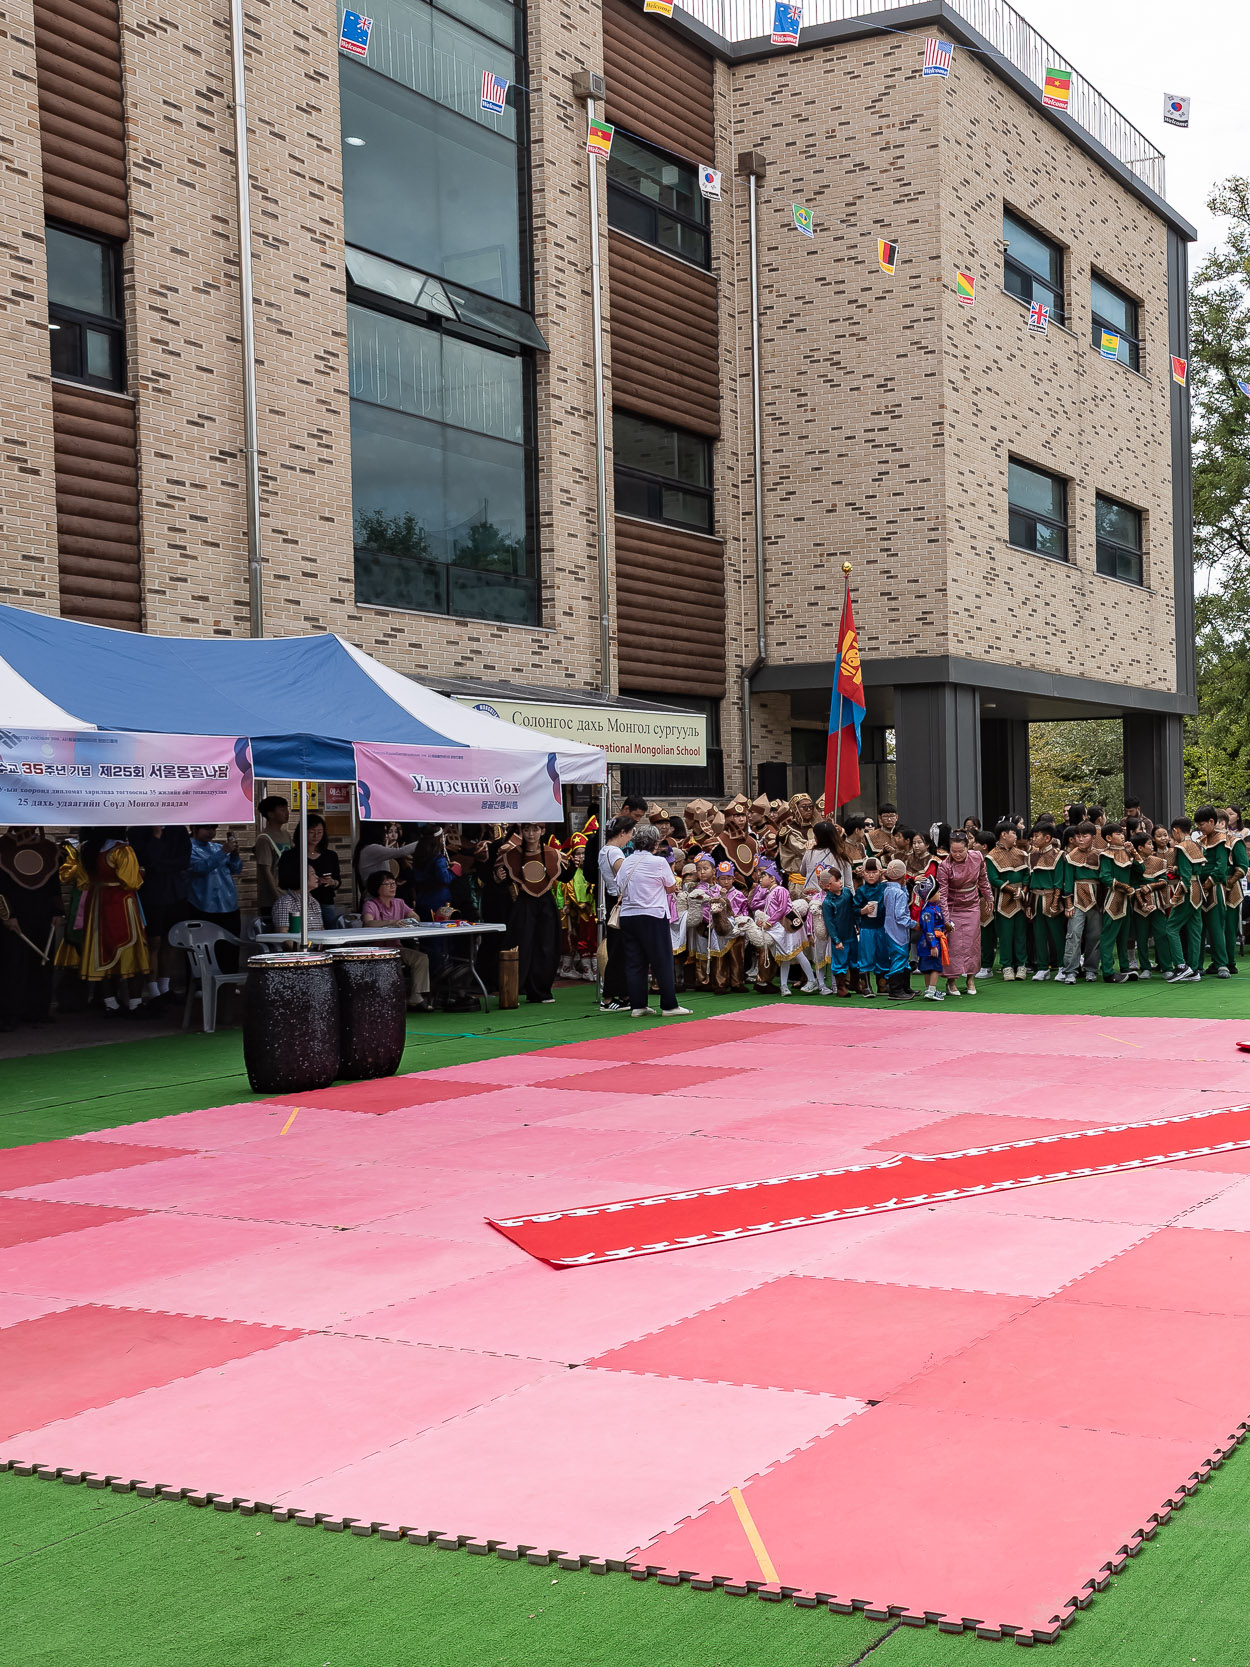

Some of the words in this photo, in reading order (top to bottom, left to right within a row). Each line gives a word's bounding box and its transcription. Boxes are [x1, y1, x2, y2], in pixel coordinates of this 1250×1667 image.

[646, 2, 671, 13] Welcome
[341, 40, 366, 55] Welcome
[482, 100, 503, 112] Welcome
[1043, 97, 1068, 108] Welcome
[1164, 117, 1188, 127] Welcome
[588, 146, 608, 158] Welcome
[512, 711, 573, 730] Солонгос
[577, 719, 604, 732] дахь
[607, 718, 650, 734] Монгол
[653, 724, 699, 739] сургууль
[634, 743, 674, 757] Mongolian
[676, 745, 700, 756] School
[22, 763, 66, 776] 35주년
[70, 765, 91, 776] 기념
[100, 765, 145, 778] 제25회
[149, 765, 228, 779] 서울몽골나담
[412, 776, 490, 793] Үндэсний
[495, 778, 520, 794] бөх
[18, 798, 29, 806] 25
[56, 799, 100, 809] удаагийн
[103, 799, 125, 809] Сөүл
[128, 799, 159, 808] Монгол
